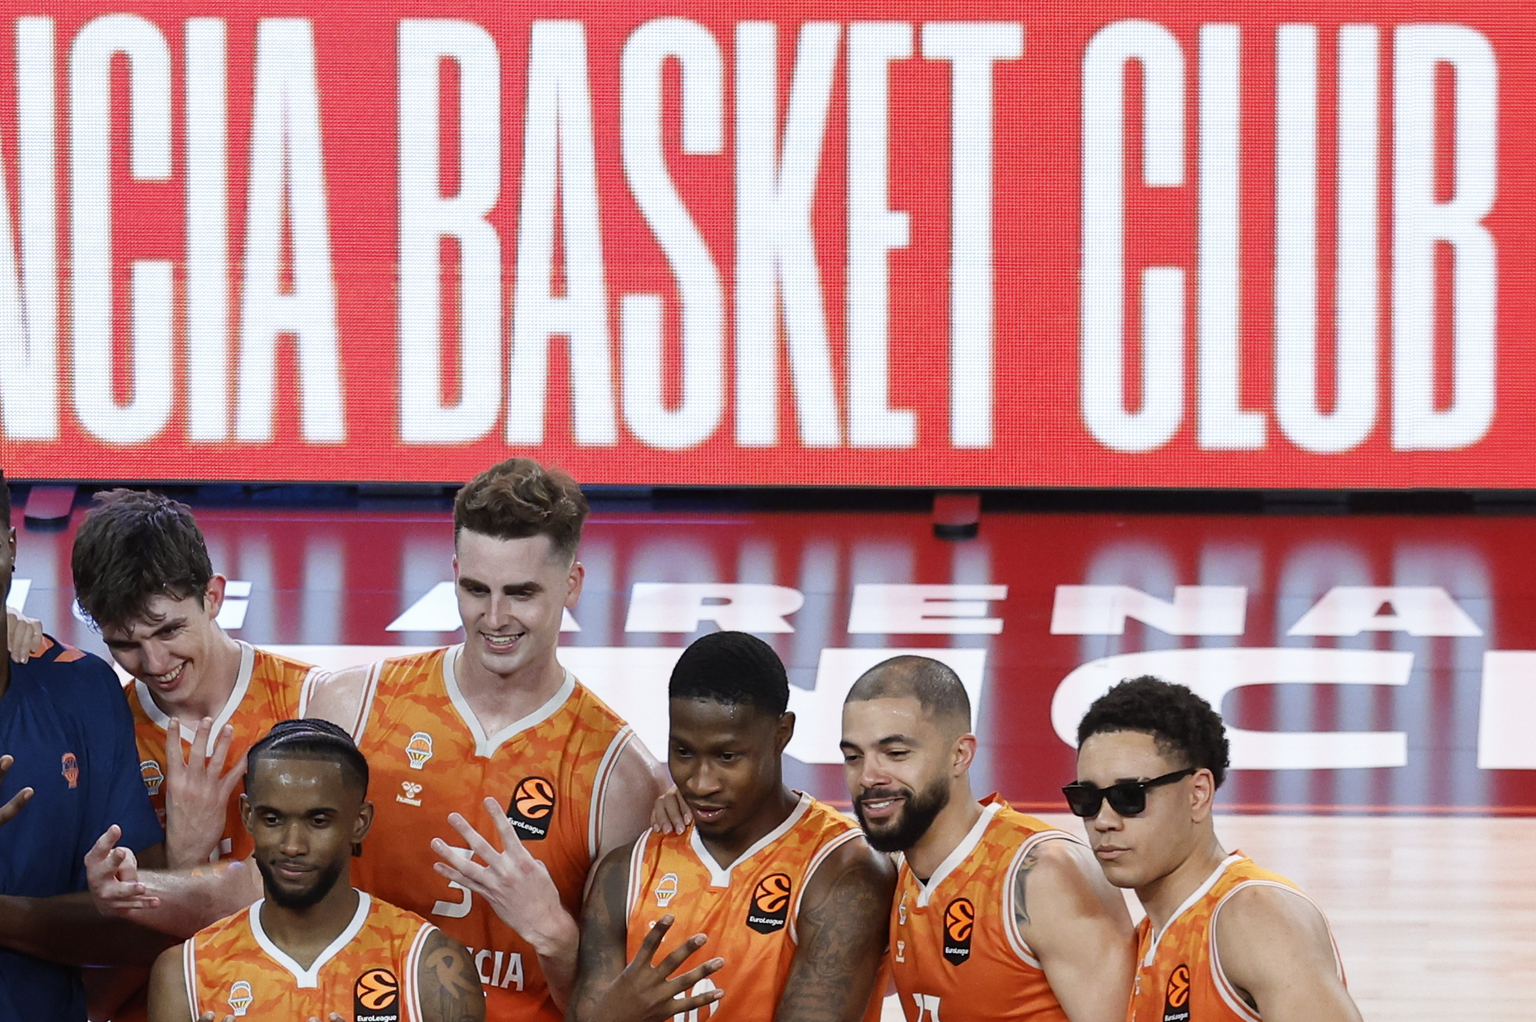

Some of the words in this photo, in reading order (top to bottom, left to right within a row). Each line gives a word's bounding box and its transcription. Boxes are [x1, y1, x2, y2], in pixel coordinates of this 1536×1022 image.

[398, 16, 1024, 450] BASKET
[1080, 20, 1500, 453] CLUB
[749, 915, 784, 927] EuroLeague
